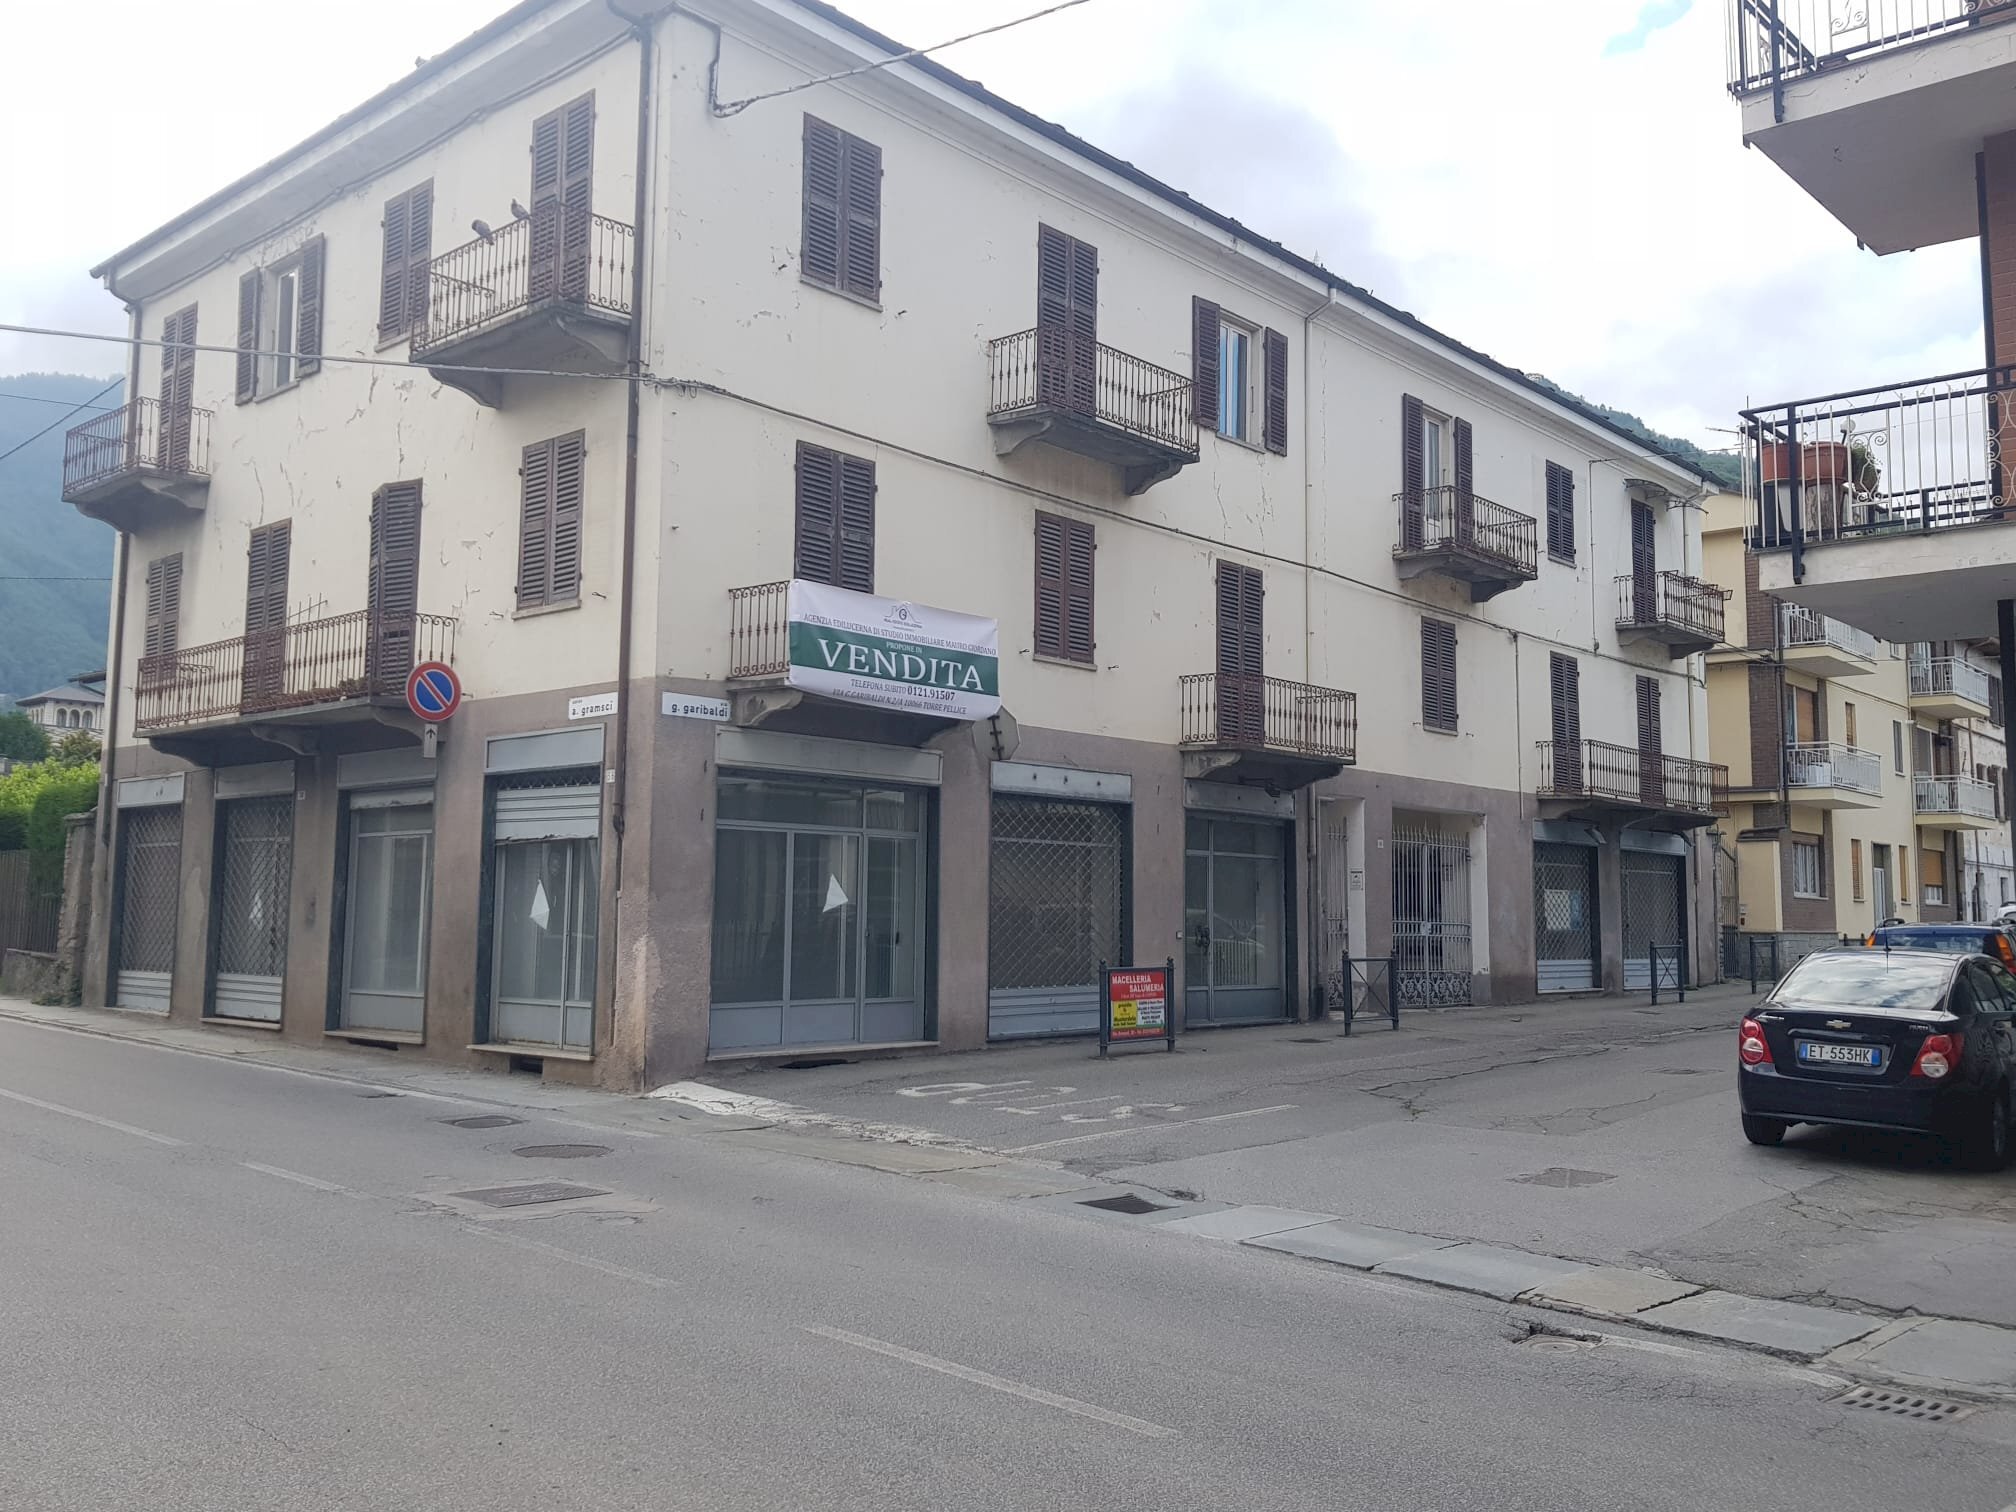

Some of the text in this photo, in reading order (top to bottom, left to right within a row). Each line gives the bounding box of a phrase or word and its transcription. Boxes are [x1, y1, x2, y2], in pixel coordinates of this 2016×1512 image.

[804, 613, 833, 627] AGENZIA
[873, 626, 881, 635] DI
[881, 628, 904, 640] STUDIO
[904, 632, 944, 647] IMMOBILIARE
[886, 640, 915, 653] PROPONE
[816, 637, 984, 691] VENDITA
[850, 678, 956, 702] TELEFONA SUBITO 0121.91507
[581, 699, 613, 716] gramsci
[671, 703, 728, 717] g. garibaldi
[922, 700, 943, 712] TORRE
[942, 703, 967, 715] PELLICE
[1111, 974, 1152, 984] MACELLERIA
[1129, 983, 1164, 993] SALUMERIA
[1809, 1045, 1870, 1062] ET 553HK
